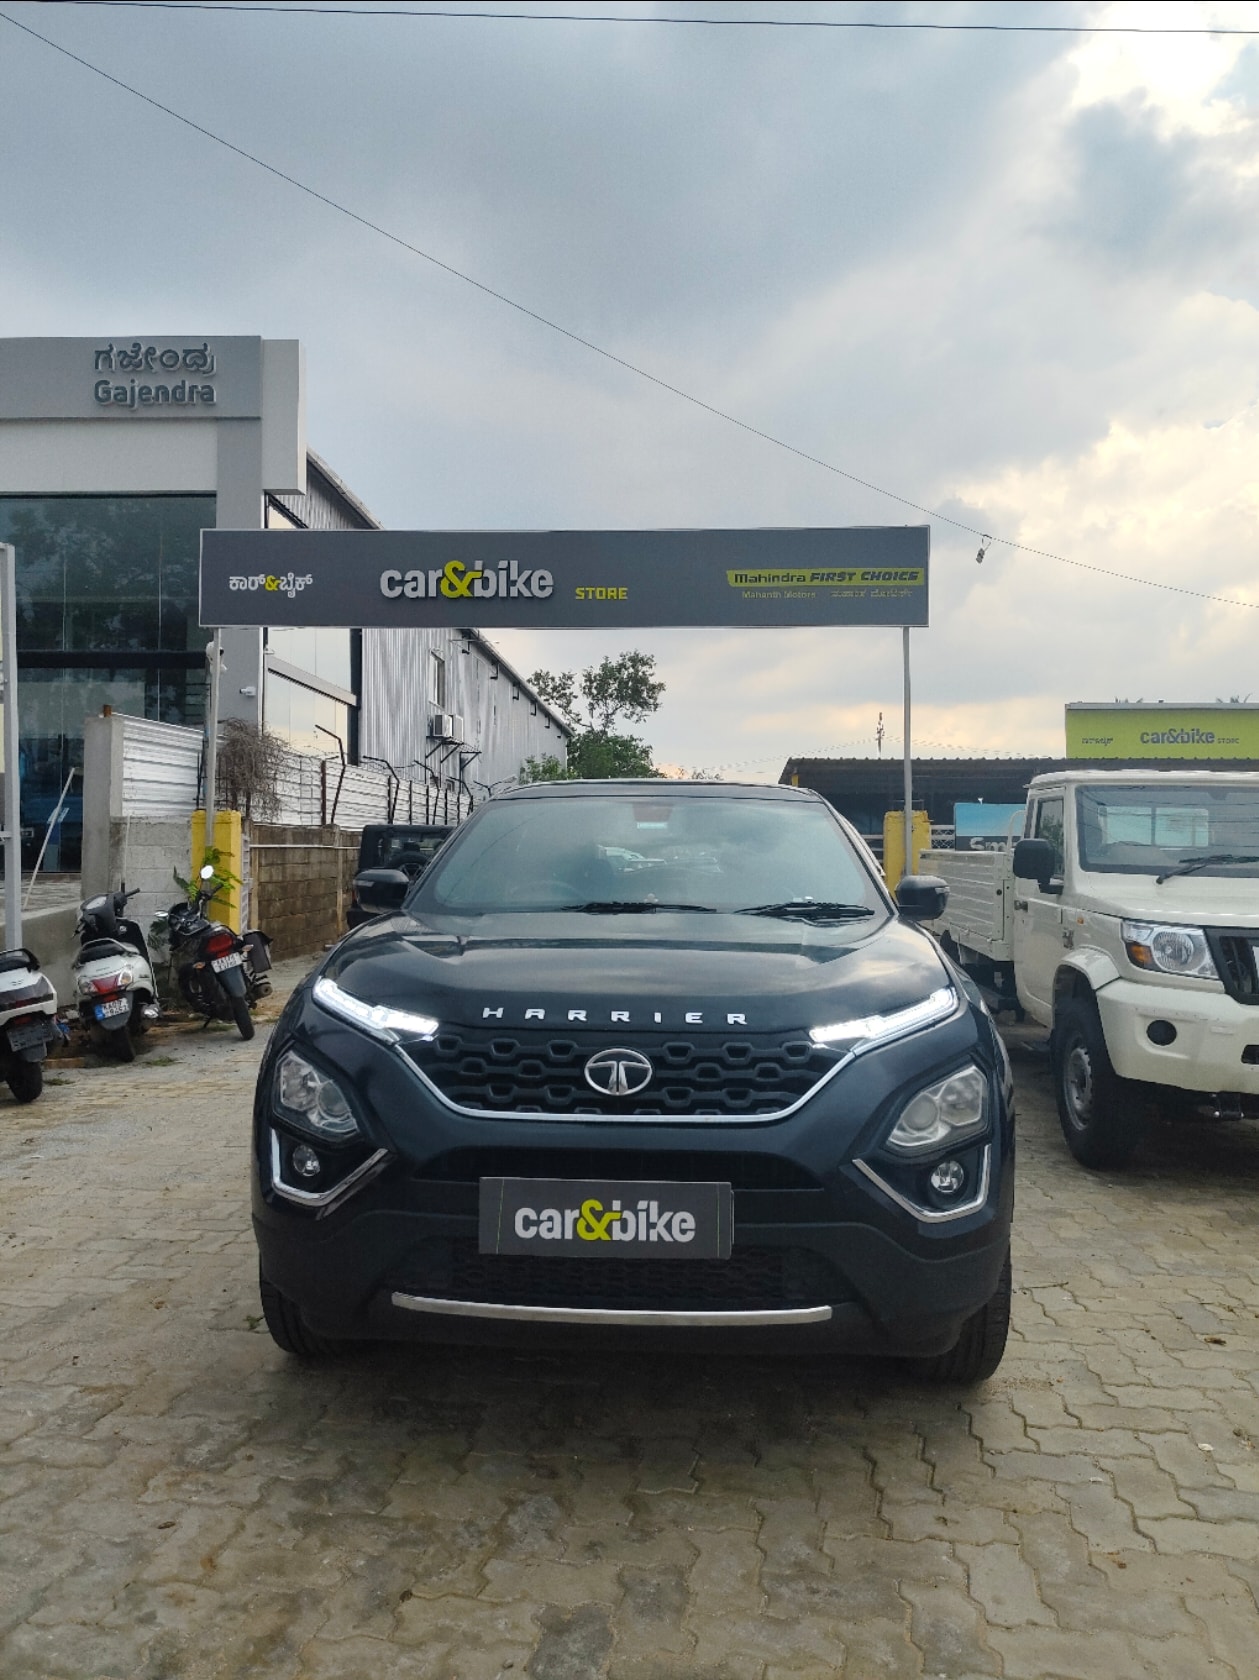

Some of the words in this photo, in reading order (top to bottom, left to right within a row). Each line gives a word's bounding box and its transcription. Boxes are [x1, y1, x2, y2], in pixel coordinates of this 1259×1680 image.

[95, 342, 216, 377] ಗಜೇಂದ್ರ
[95, 379, 216, 411] Gajendra
[380, 560, 554, 599] car&bike
[734, 572, 806, 584] Mahindra
[808, 572, 857, 583] FIRST
[860, 570, 919, 582] CHOICE
[575, 587, 628, 600] STORE
[1140, 728, 1215, 744] car&bike
[482, 1007, 747, 1025] HARRIER
[514, 1199, 696, 1242] car&bike
